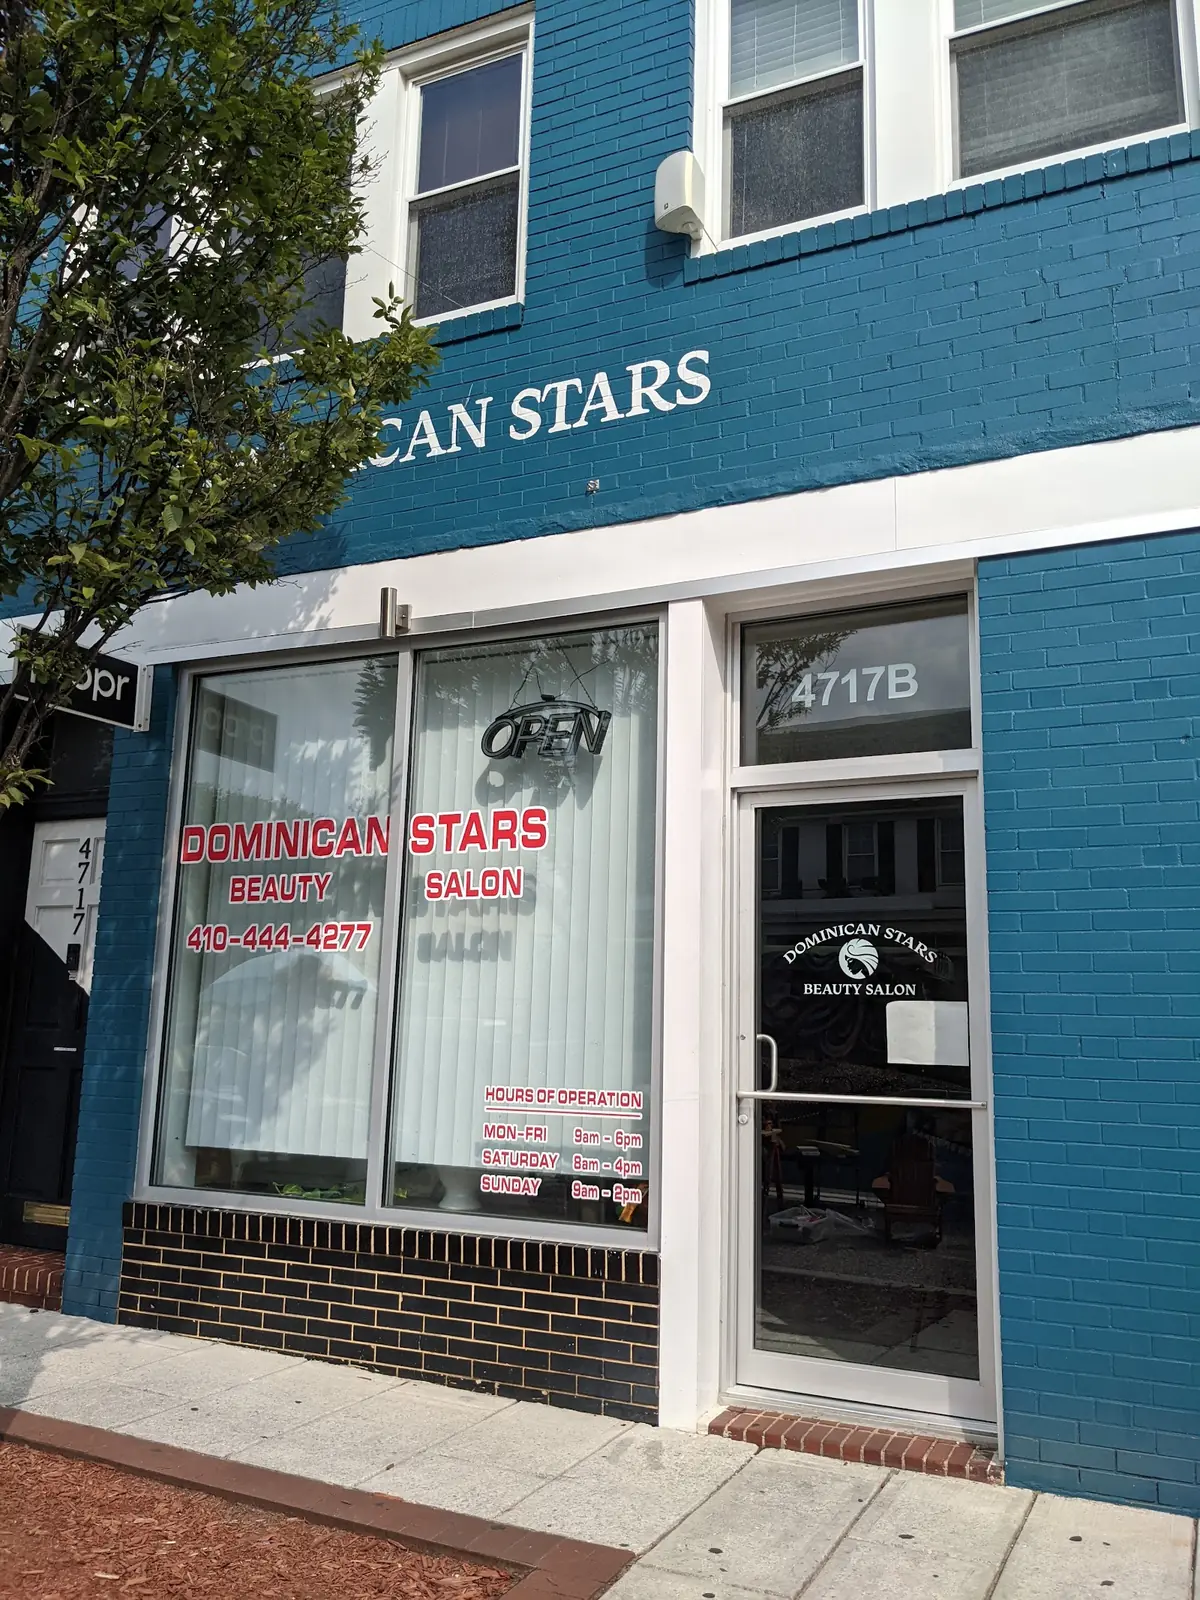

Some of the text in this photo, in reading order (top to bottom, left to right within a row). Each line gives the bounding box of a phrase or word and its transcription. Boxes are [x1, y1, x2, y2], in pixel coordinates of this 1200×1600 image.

[509, 350, 711, 440] STARS
[792, 663, 918, 708] 4717B
[481, 709, 612, 759] OPEN
[180, 806, 549, 865] DOMINICAN STARS
[229, 866, 524, 904] BEAUTY SALON
[186, 921, 374, 953] 410-444-4277
[783, 923, 938, 964] DOMINICAN STARS
[803, 983, 917, 996] BEAUTY SALON
[485, 1085, 643, 1109] HOURS OF OPERATION
[483, 1123, 548, 1142] MON-FRI
[573, 1127, 599, 1145] 9am
[614, 1129, 643, 1150] 6pm
[482, 1149, 559, 1170] SATURDAY
[572, 1153, 599, 1172] 8am
[613, 1157, 642, 1178] 4pm
[480, 1175, 541, 1196] SUNDAY
[571, 1181, 599, 1200] 9am
[613, 1184, 642, 1206] 2pm
